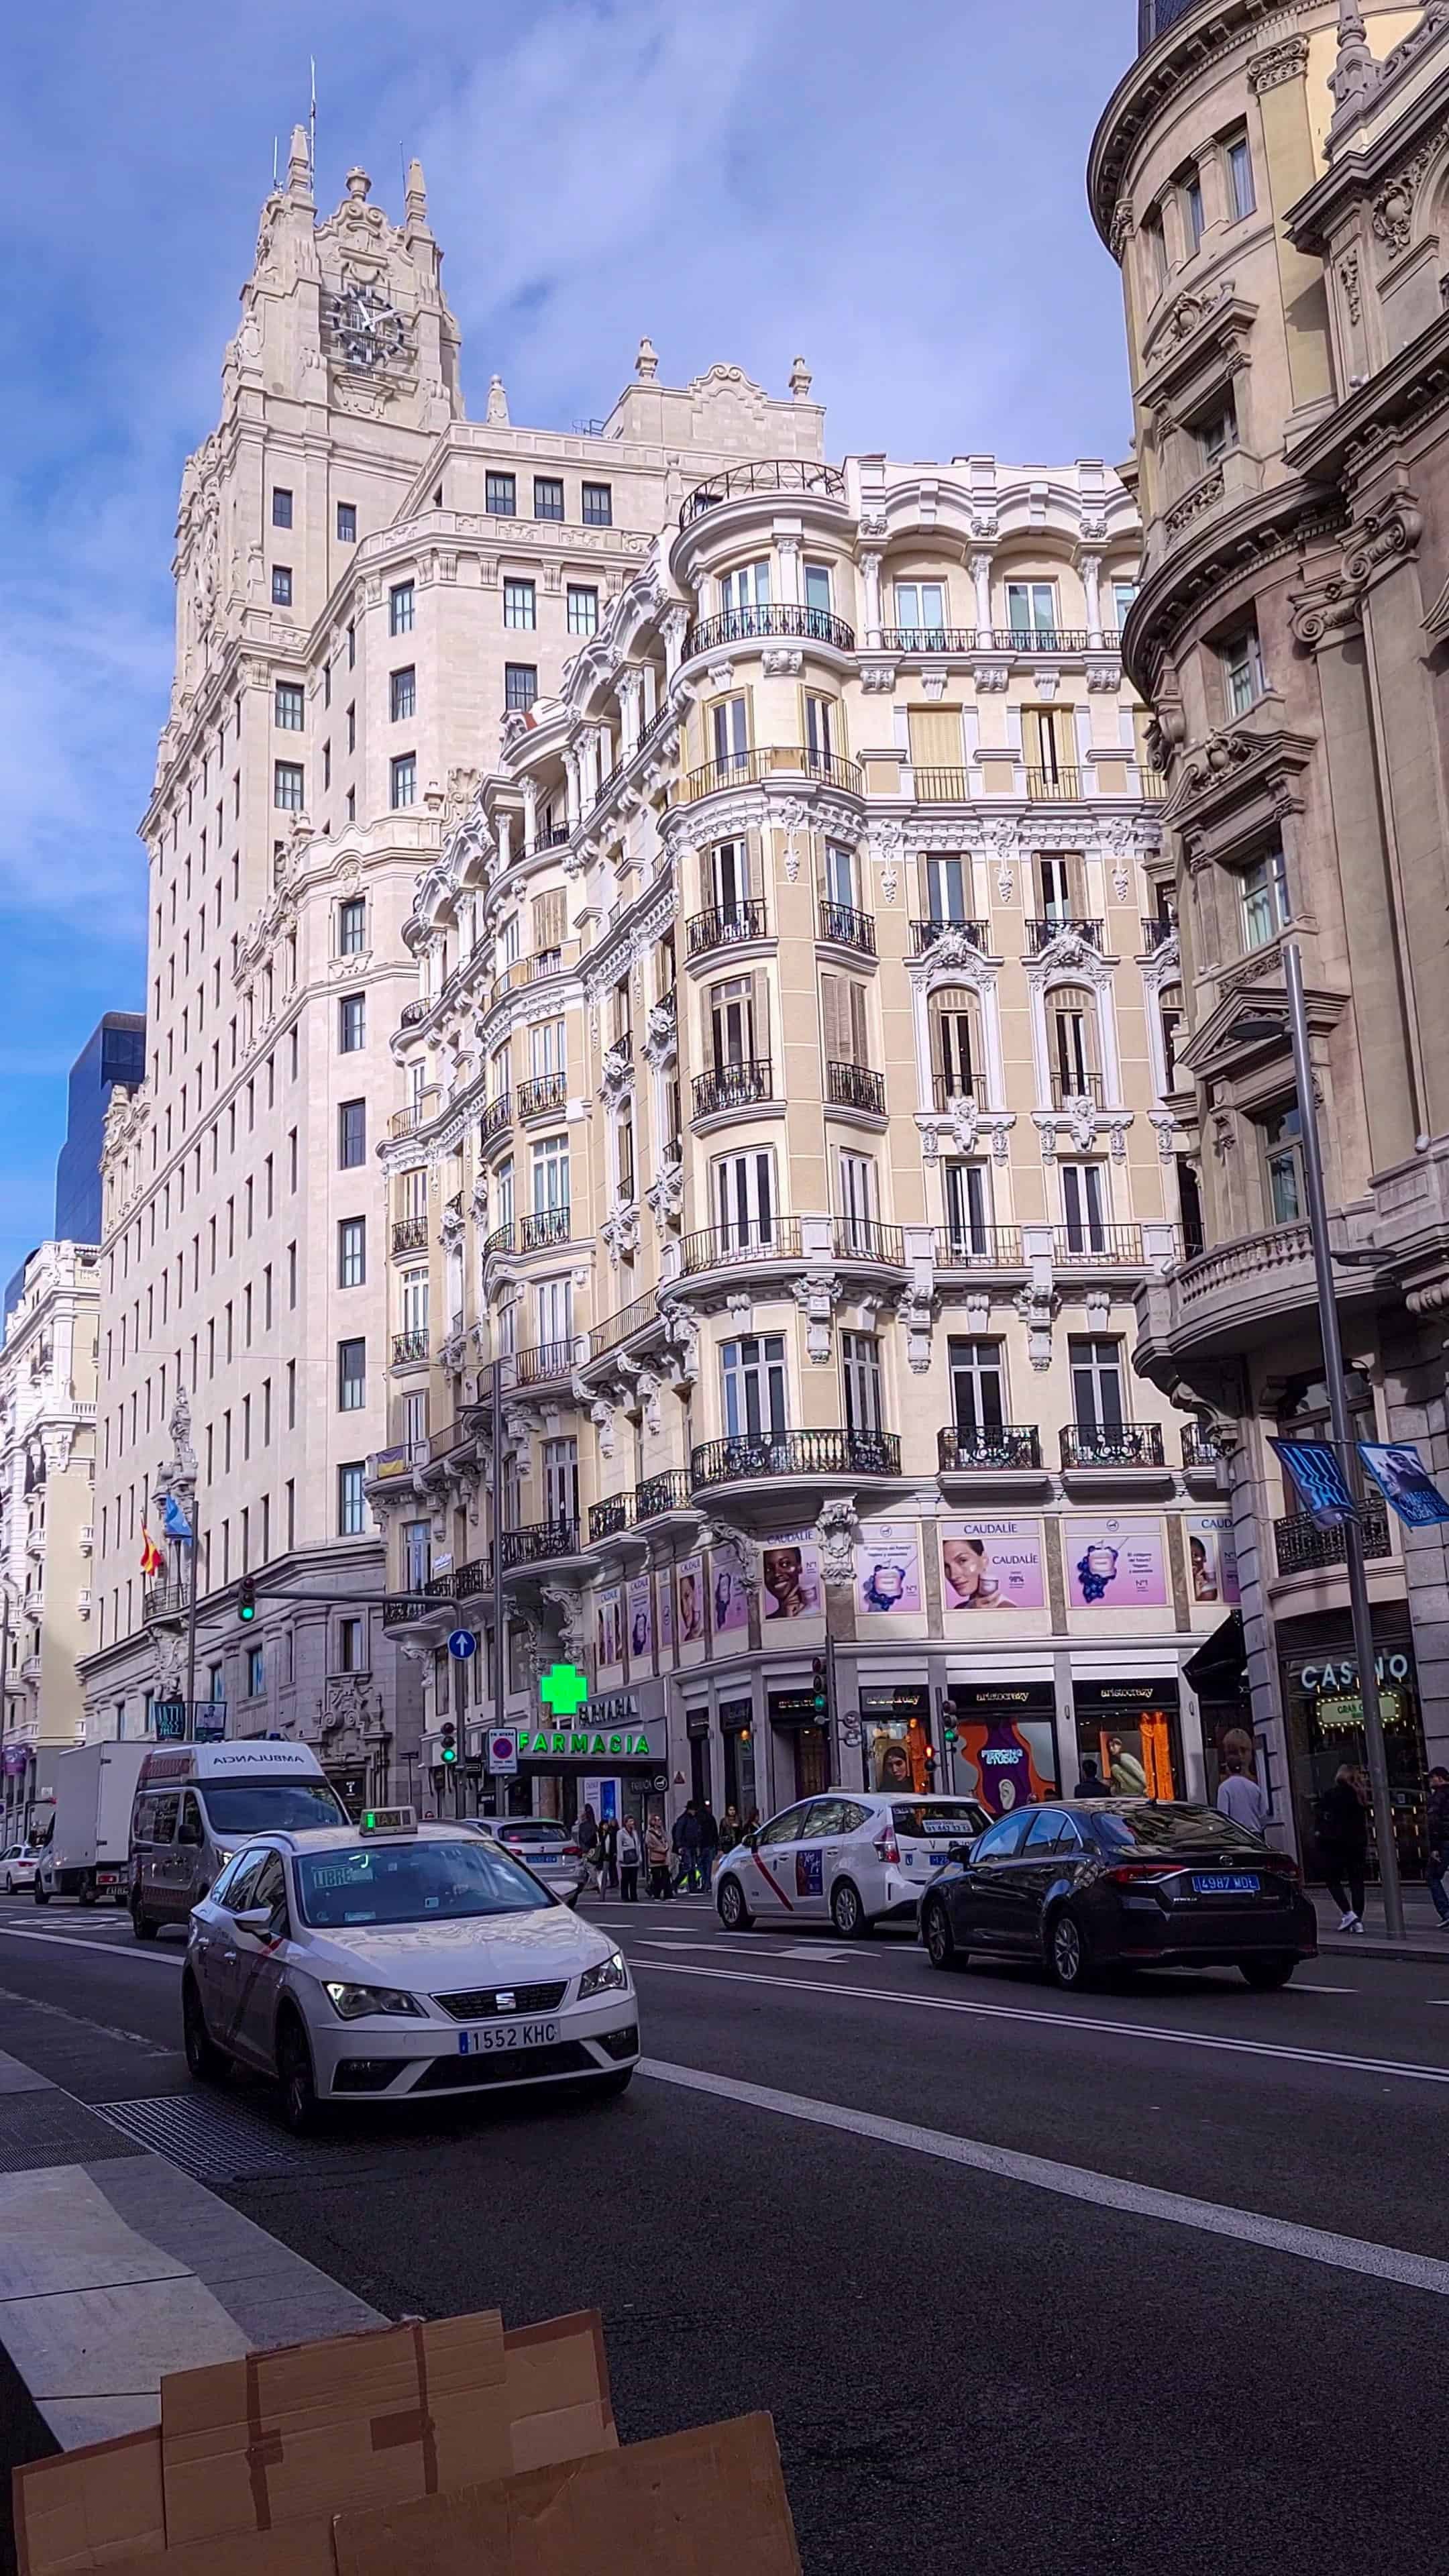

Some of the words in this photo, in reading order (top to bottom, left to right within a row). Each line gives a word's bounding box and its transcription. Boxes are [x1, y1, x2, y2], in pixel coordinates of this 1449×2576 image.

[1301, 1654, 1408, 1688] CASNO
[976, 1692, 1029, 1702] aristocrazy
[1101, 1688, 1153, 1698] aristocrazy
[518, 1732, 650, 1755] FARMACIA
[1201, 1878, 1230, 1888] 4987
[473, 2028, 517, 2051] 1552
[523, 2023, 555, 2045] KHC
